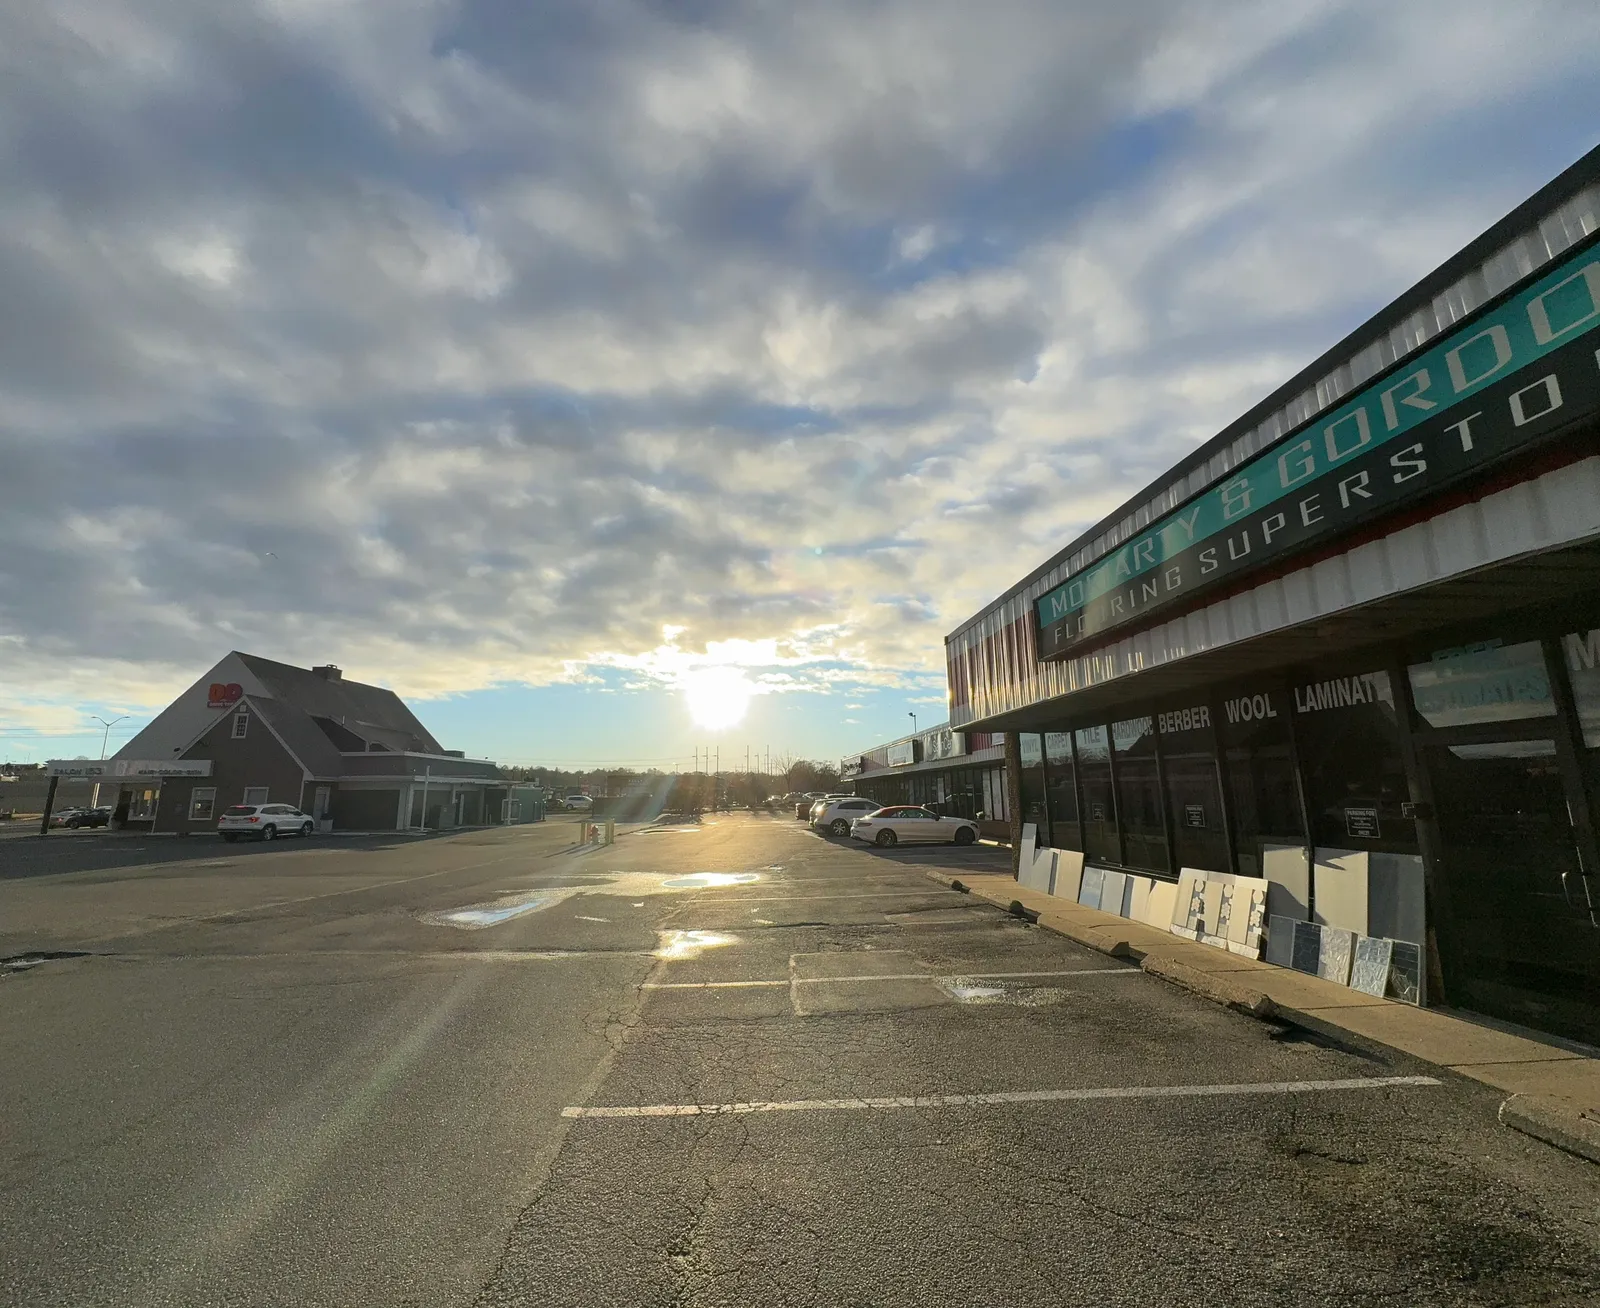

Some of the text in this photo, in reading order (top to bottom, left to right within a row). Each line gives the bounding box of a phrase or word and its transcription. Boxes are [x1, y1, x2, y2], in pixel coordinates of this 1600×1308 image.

[1198, 349, 1600, 576] SUPERSTO
[1051, 506, 1201, 618] MOARTY
[1221, 478, 1254, 520] &
[1081, 727, 1101, 745] TILE
[1158, 705, 1211, 734] BERBER
[1224, 693, 1277, 723] WOOL
[1294, 671, 1390, 713] LAMINAT
